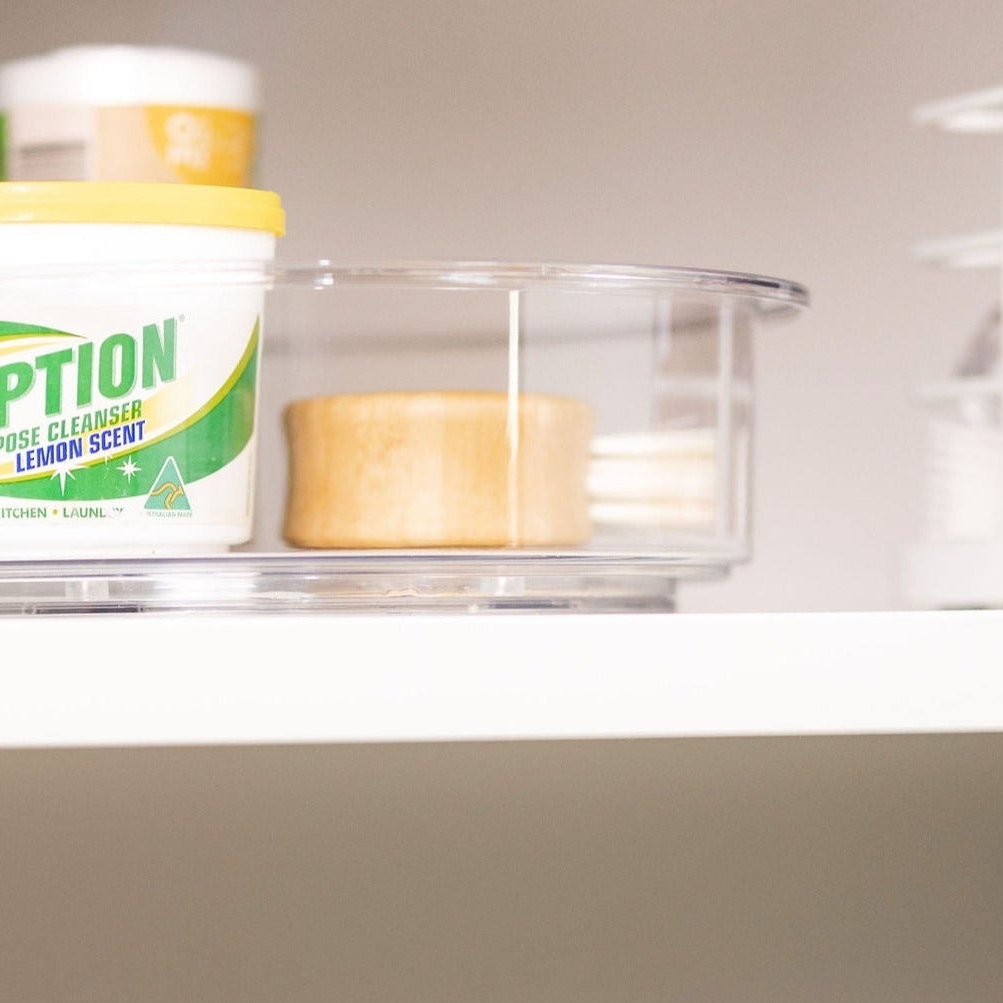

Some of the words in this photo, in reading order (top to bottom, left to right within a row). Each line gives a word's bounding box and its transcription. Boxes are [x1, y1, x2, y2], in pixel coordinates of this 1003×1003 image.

[47, 399, 143, 443] CLEANSER
[15, 439, 84, 474] LEMON
[88, 421, 147, 454] SCENT
